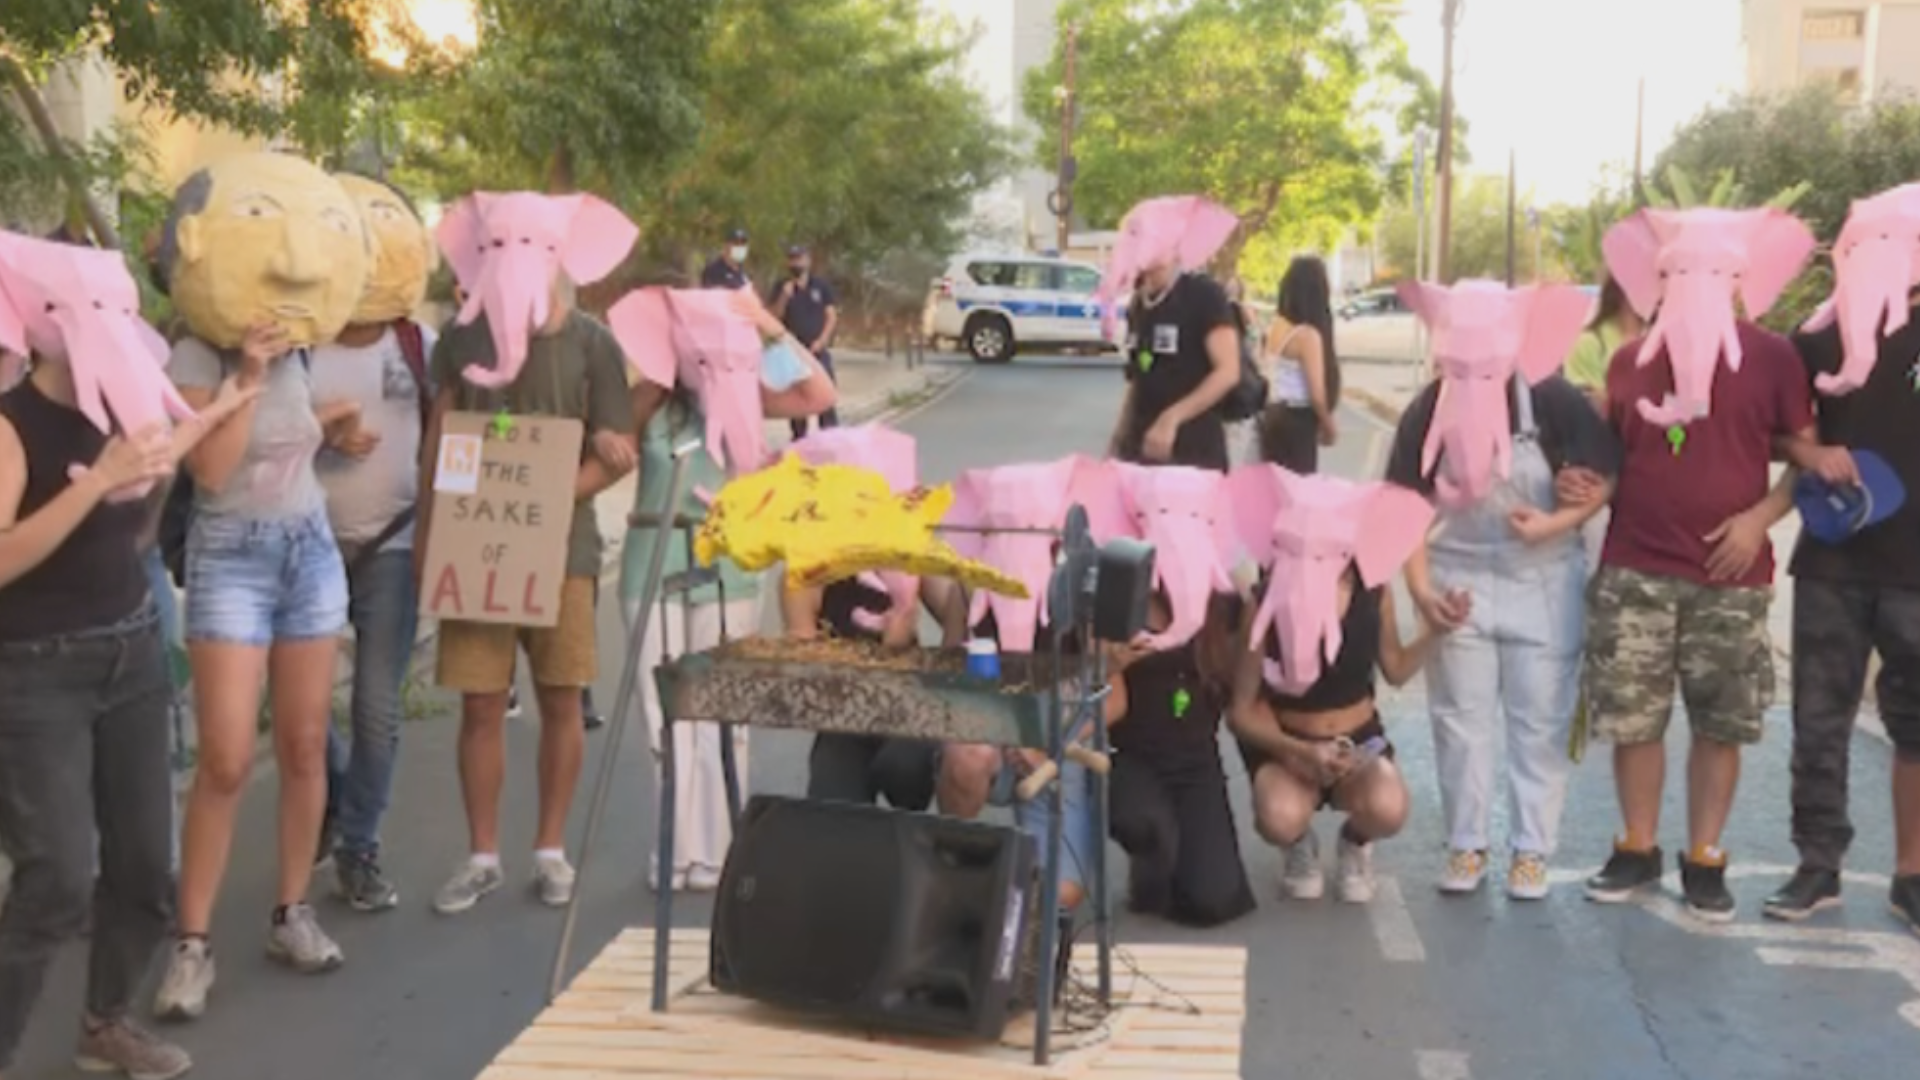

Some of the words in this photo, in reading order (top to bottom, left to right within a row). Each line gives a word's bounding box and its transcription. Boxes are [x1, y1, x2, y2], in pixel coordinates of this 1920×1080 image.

[482, 461, 530, 486] THE
[452, 497, 542, 526] SAKE
[482, 544, 508, 563] OF
[430, 563, 544, 615] ALL
